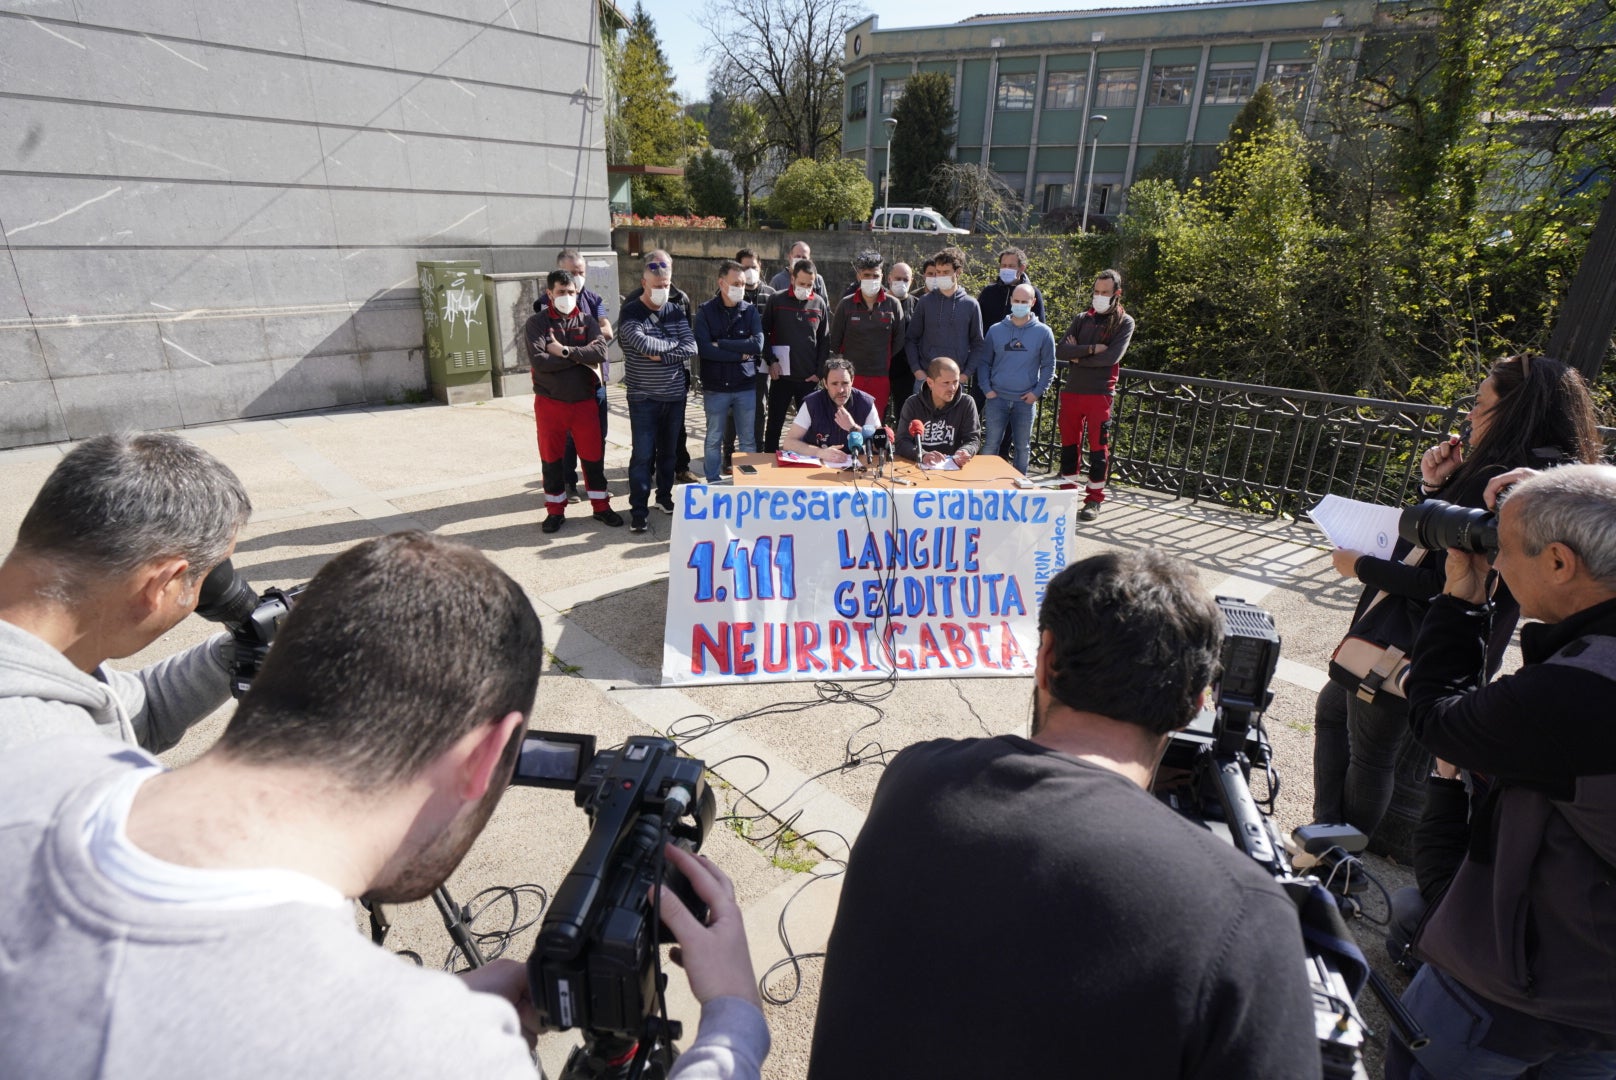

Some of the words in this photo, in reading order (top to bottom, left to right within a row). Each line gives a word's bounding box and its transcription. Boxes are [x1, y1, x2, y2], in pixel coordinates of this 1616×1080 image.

[684, 485, 887, 528] Enpresaren
[837, 526, 981, 573] LANGILE
[1050, 514, 1066, 574] tzordea
[687, 534, 797, 603] 1.411
[834, 573, 1027, 619] GELDITUTA
